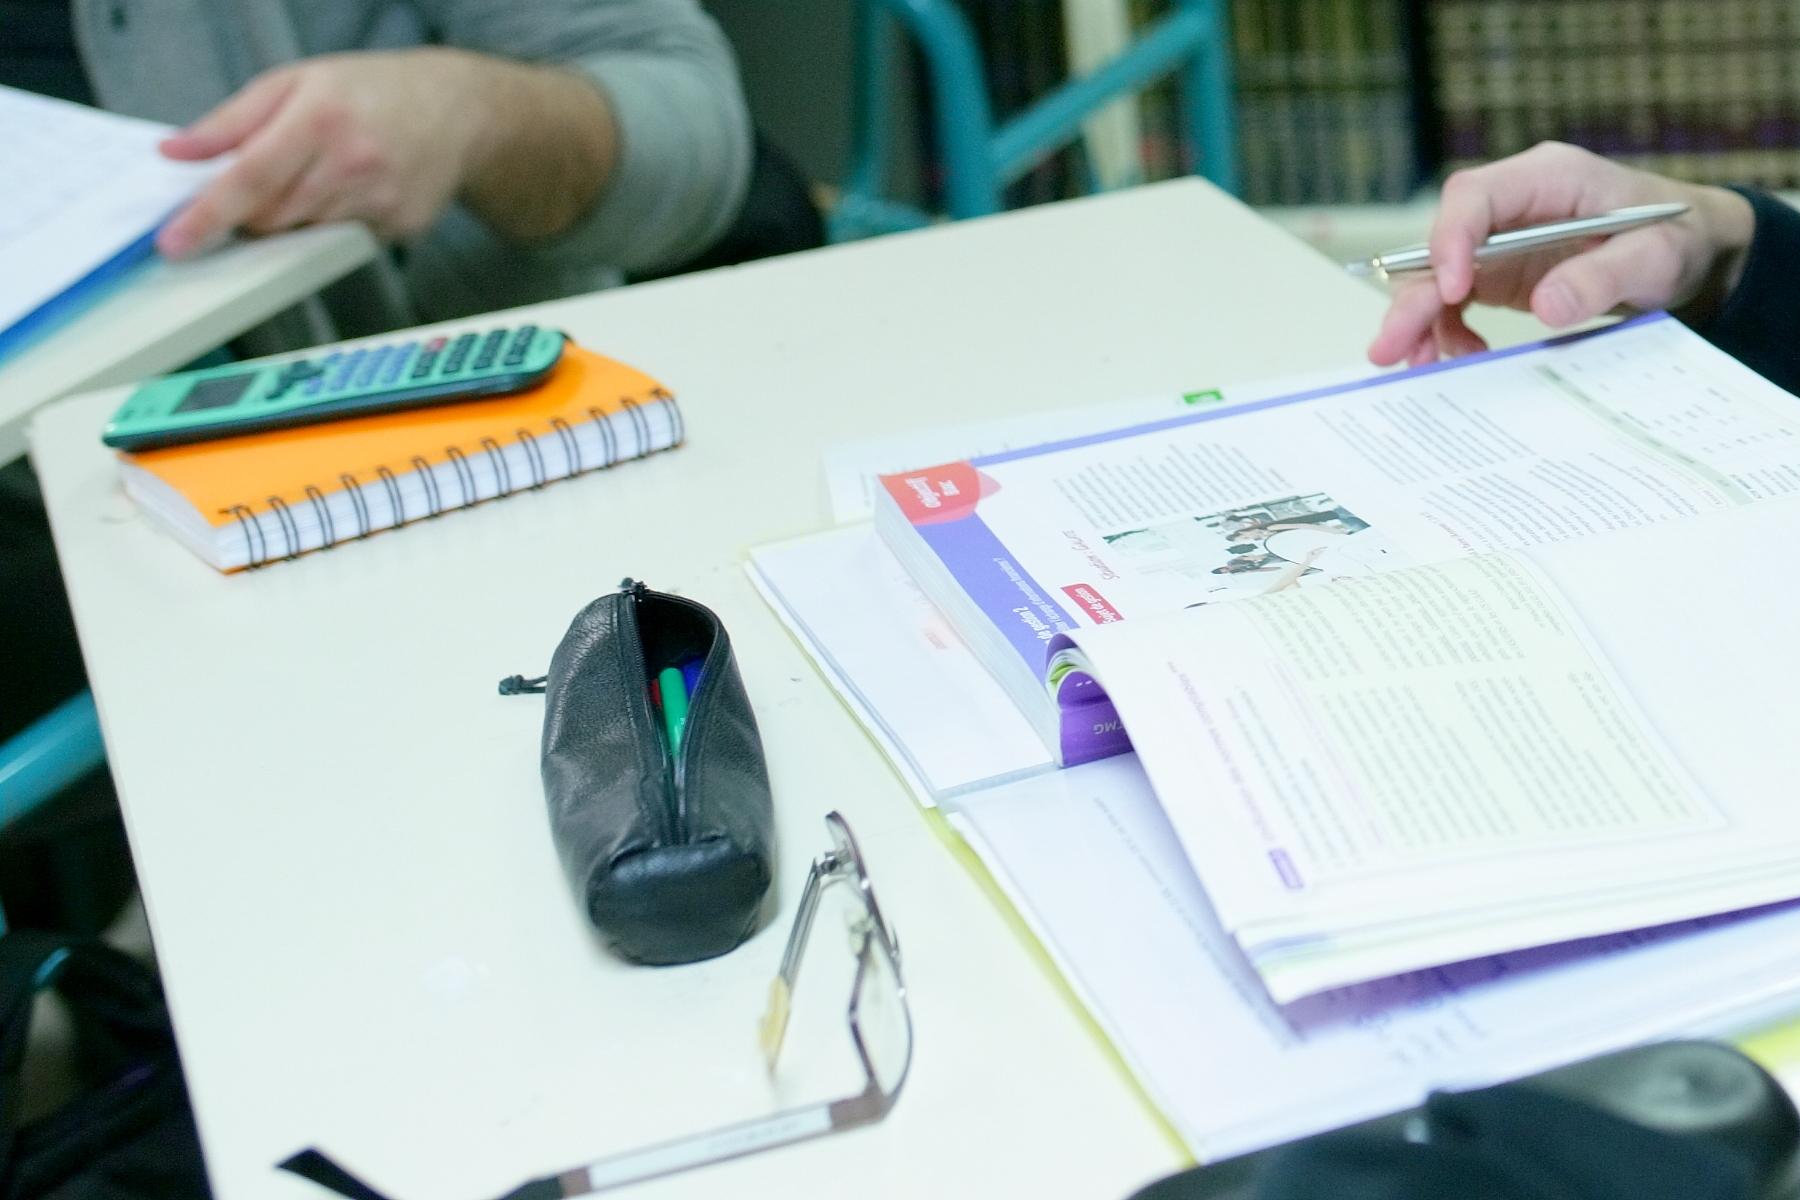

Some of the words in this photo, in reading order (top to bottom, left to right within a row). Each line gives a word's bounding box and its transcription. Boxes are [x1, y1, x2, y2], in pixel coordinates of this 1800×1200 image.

[1073, 587, 1102, 603] gestion
[1016, 609, 1050, 631] gestion
[1093, 607, 1119, 624] Sujet
[1093, 720, 1125, 735] TMG
